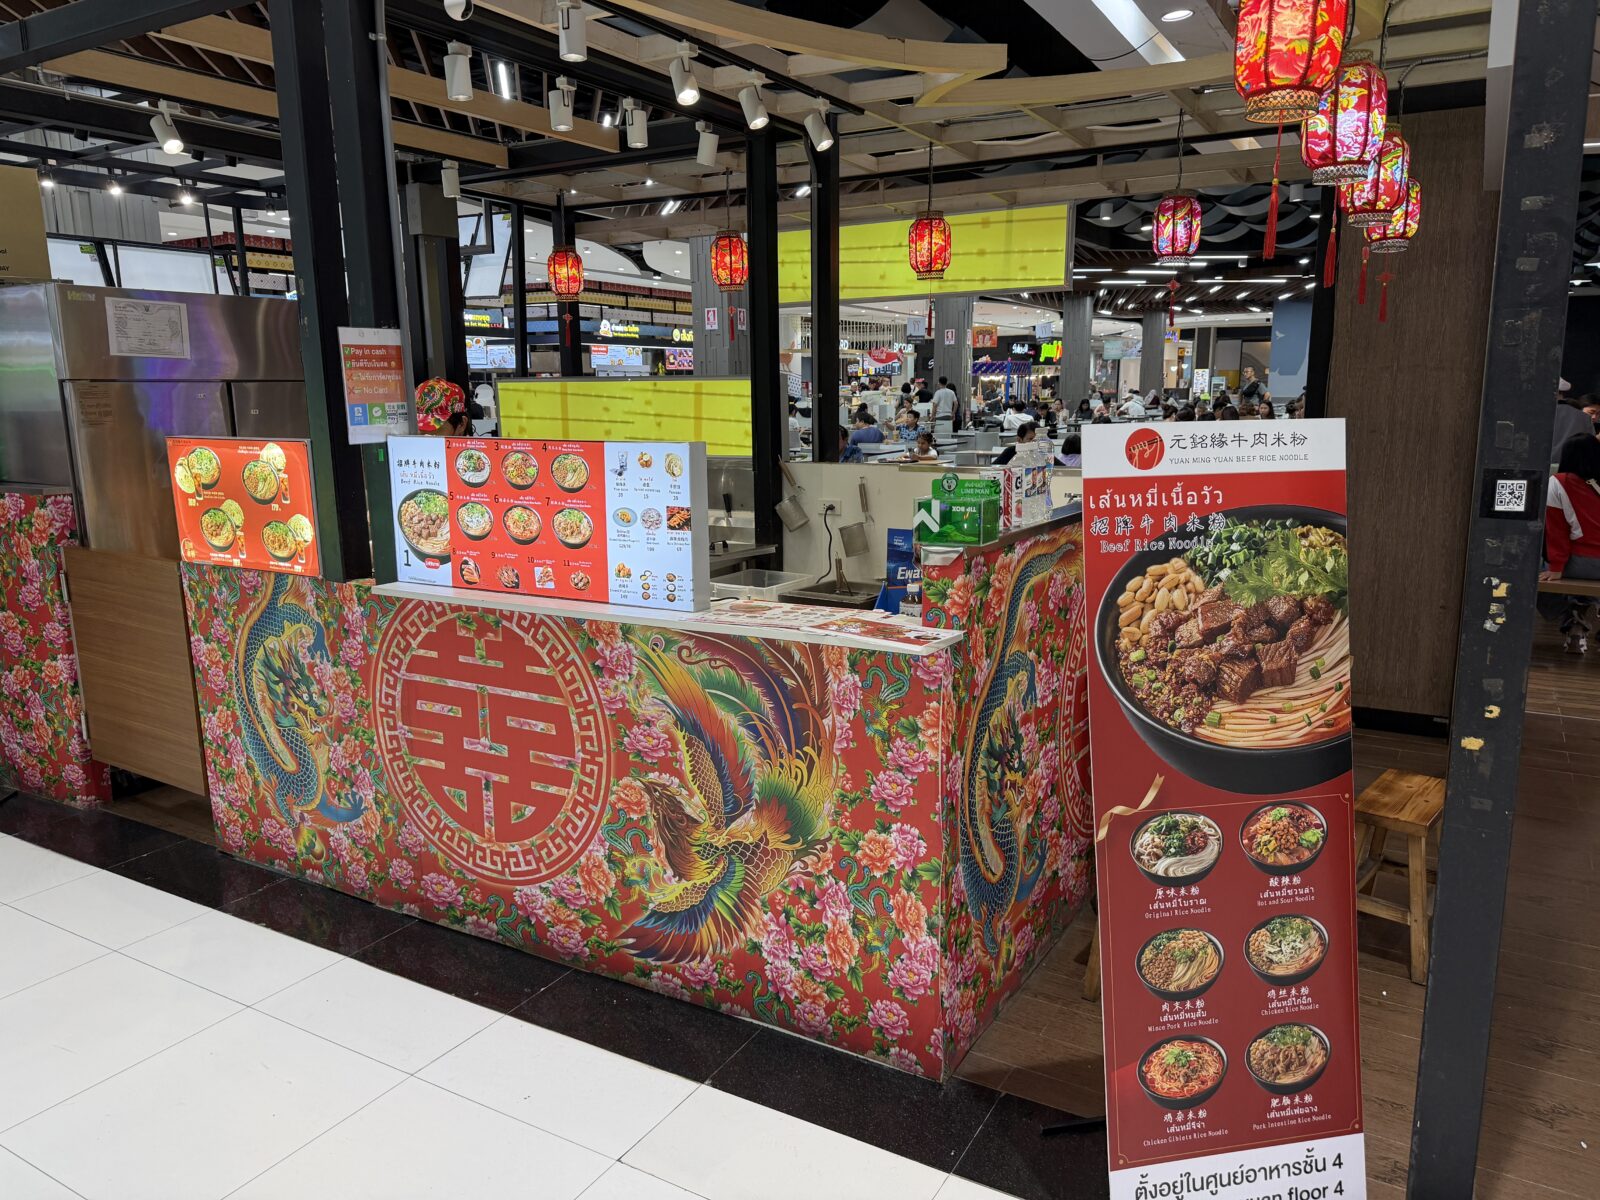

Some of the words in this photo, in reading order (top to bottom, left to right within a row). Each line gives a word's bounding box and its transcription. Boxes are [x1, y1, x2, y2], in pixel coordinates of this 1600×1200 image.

[351, 348, 362, 356] Pay
[374, 386, 388, 394] Card
[447, 440, 451, 448] 2
[494, 442, 499, 450] 3
[542, 443, 547, 452] 4
[1192, 456, 1211, 464] MING
[1259, 454, 1276, 462] RICE
[450, 492, 454, 500] 5
[494, 495, 499, 503] 6
[1089, 482, 1223, 509] เส้นหมี่เนื้อวัว
[546, 497, 550, 506] 7
[1090, 512, 1226, 536] 招牌牛肉米粉
[1100, 539, 1131, 553] Beef
[1134, 538, 1165, 552] Rice
[1168, 536, 1214, 550] Noodle
[404, 550, 412, 566] 1
[897, 566, 922, 579] Ewa
[1144, 911, 1172, 919] Original
[1261, 1008, 1284, 1016] Chicken
[1167, 1022, 1180, 1030] Pork
[1268, 1119, 1296, 1128] Intestine
[1332, 1152, 1344, 1169] 4
[1288, 1186, 1328, 1200] floor
[1334, 1180, 1344, 1196] 4
